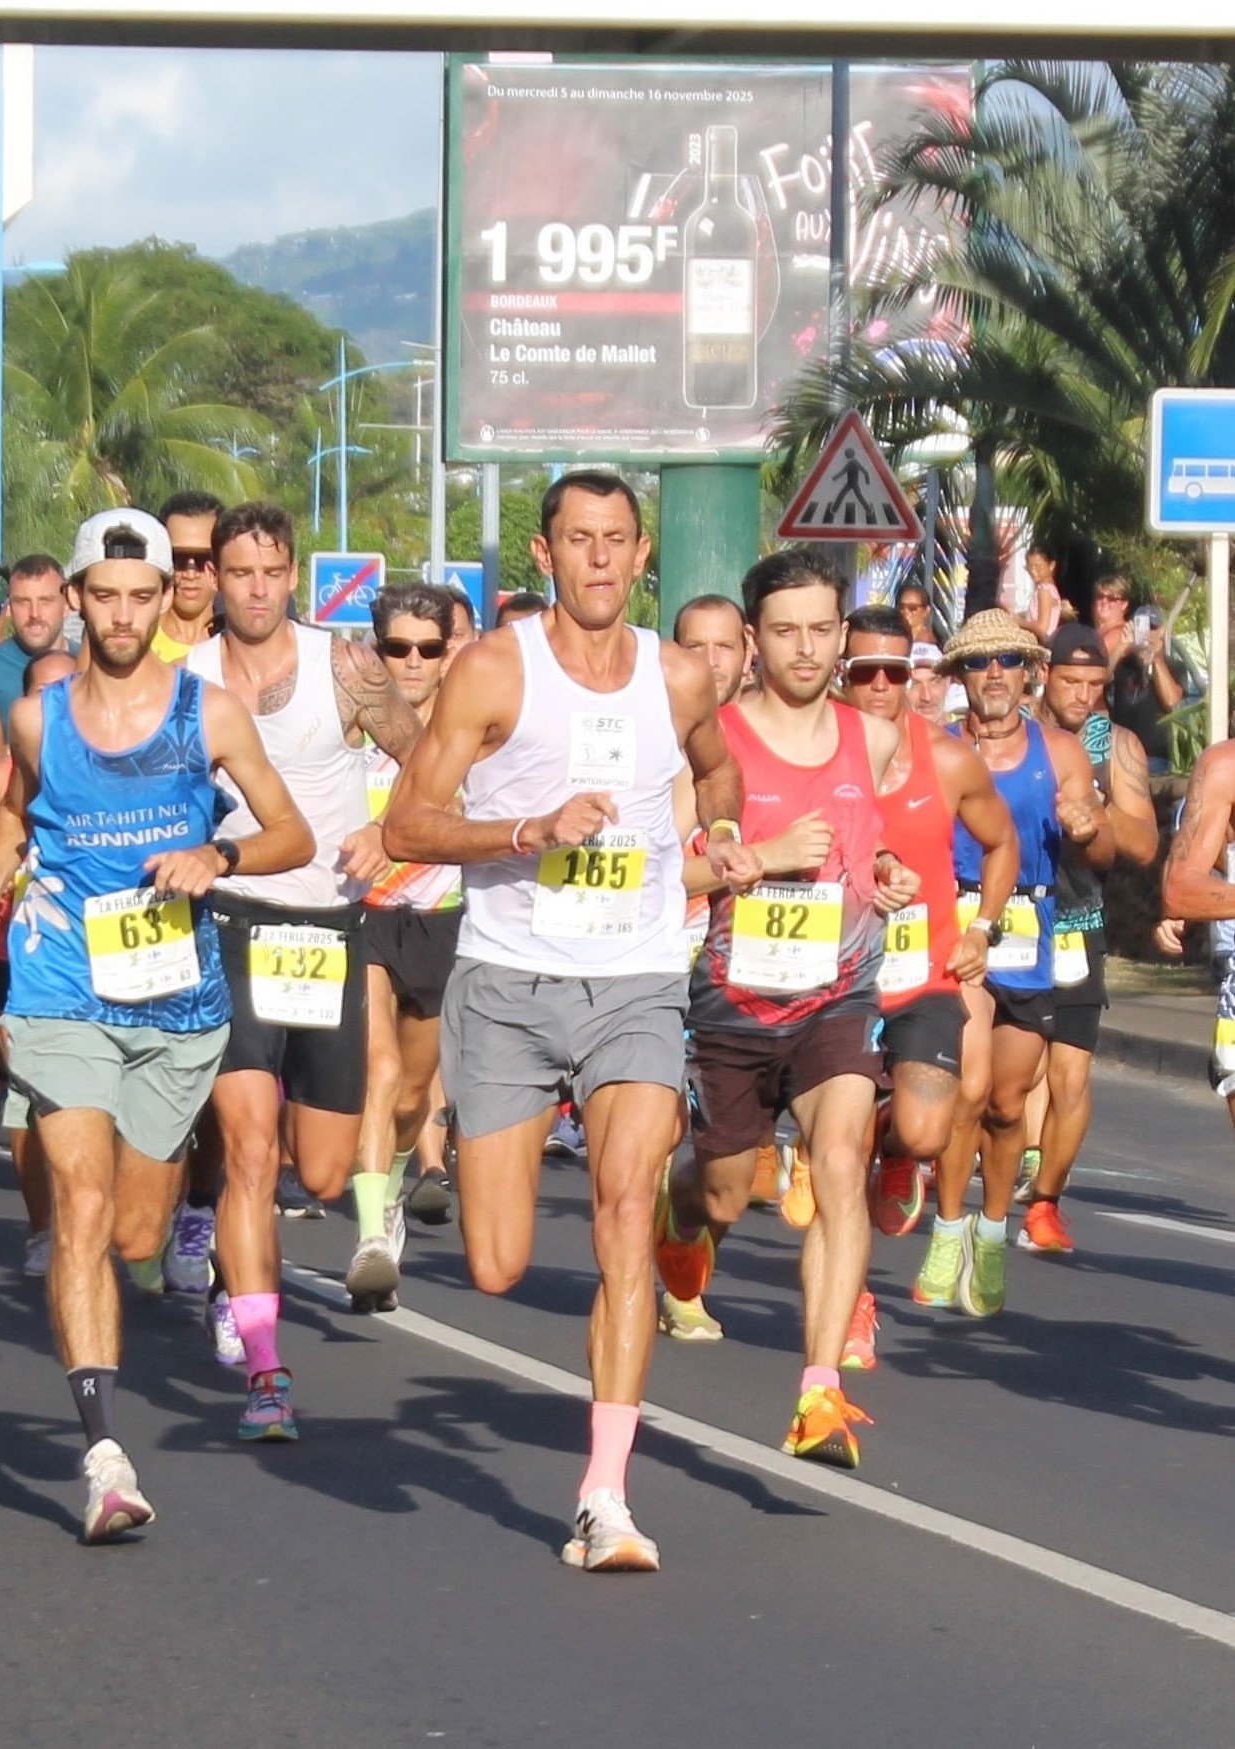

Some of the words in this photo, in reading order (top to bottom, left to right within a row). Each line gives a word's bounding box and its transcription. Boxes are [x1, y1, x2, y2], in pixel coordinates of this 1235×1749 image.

[487, 86, 504, 97] Du
[507, 86, 557, 98] mercredi
[561, 86, 567, 98] 5
[570, 89, 585, 98] au
[588, 87, 644, 100] dimanche
[648, 89, 661, 100] 16
[664, 89, 723, 101] novembre
[726, 90, 754, 101] 2025
[689, 133, 702, 164] 2023
[481, 221, 507, 282] 1
[490, 295, 558, 309] BORDEAUX
[490, 318, 560, 336] Château
[490, 345, 510, 362] Le
[516, 345, 570, 363] Comte
[576, 345, 596, 362] de
[602, 345, 656, 364] Mallet
[490, 371, 508, 385] 75
[513, 370, 529, 385] cl.
[596, 717, 624, 729] STC
[66, 813, 92, 828] AIR
[94, 807, 154, 827] TAHITI
[158, 802, 188, 819] NUI
[67, 820, 189, 848] RUNNING
[610, 834, 637, 848] 2025
[562, 850, 629, 889] 165
[766, 886, 796, 899] FERIA
[799, 887, 829, 900] 2025
[99, 901, 112, 914] LA
[114, 894, 144, 912] FERIA
[766, 903, 810, 940] 82
[893, 910, 917, 922] 2025
[120, 908, 164, 950] 63
[307, 932, 333, 945] 2025
[271, 946, 327, 979] 132
